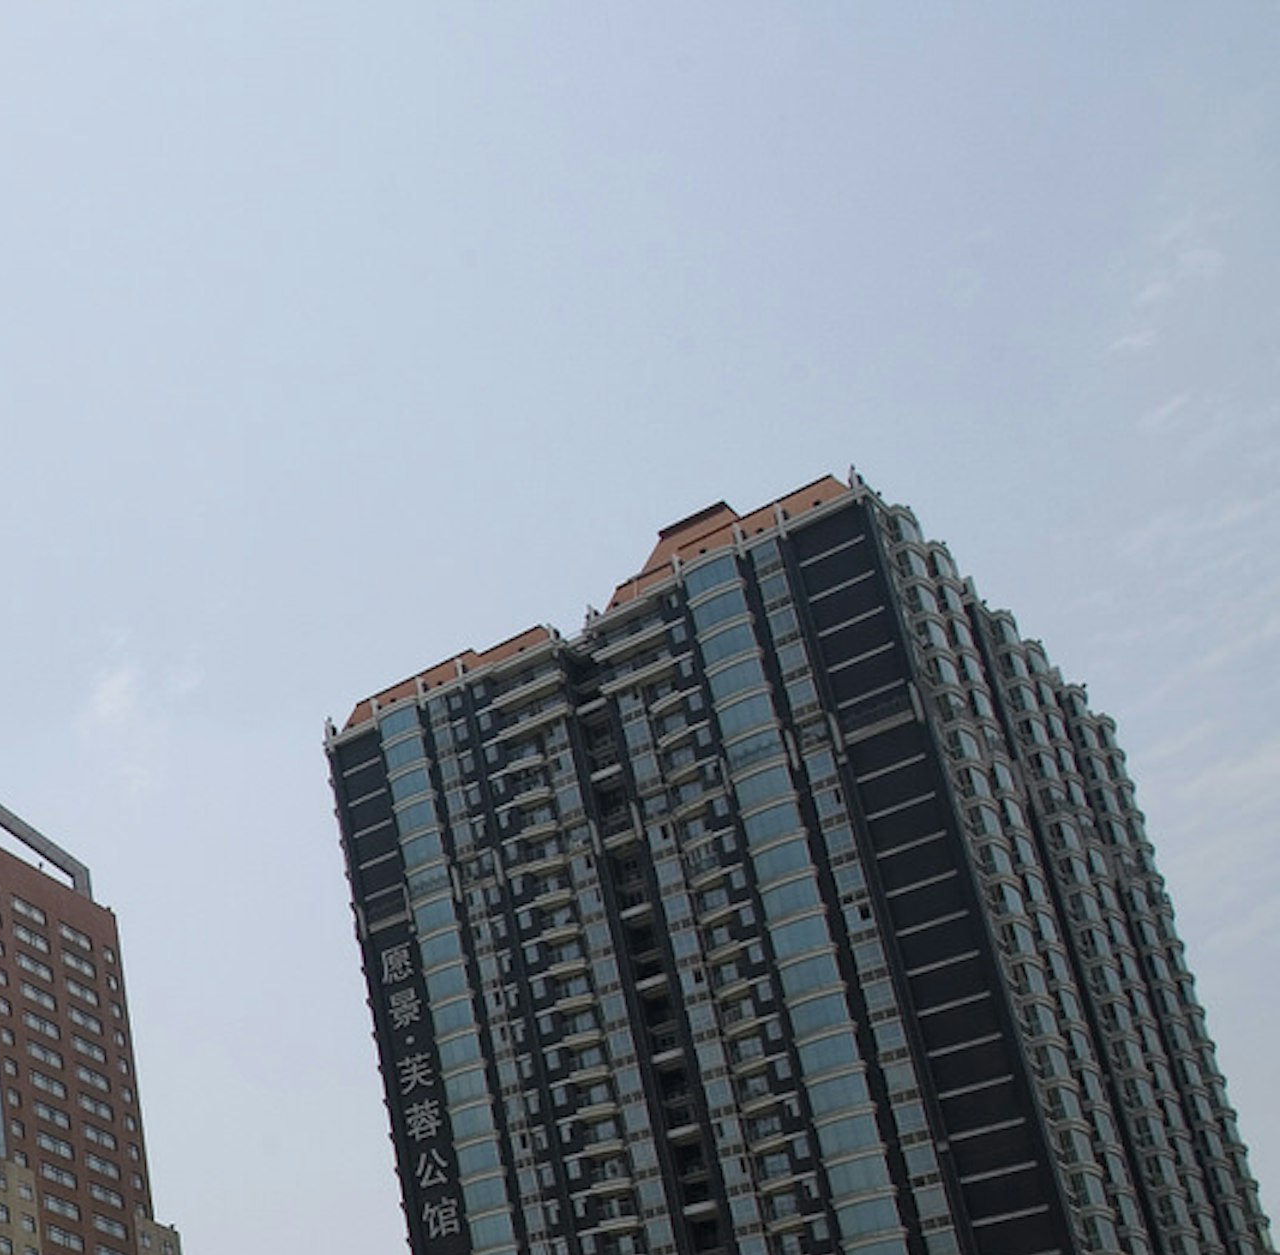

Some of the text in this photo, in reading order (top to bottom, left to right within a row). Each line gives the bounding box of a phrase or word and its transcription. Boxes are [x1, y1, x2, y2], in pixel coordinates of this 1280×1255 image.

[380, 941, 461, 1239] 愿景·芙蓉公馆
